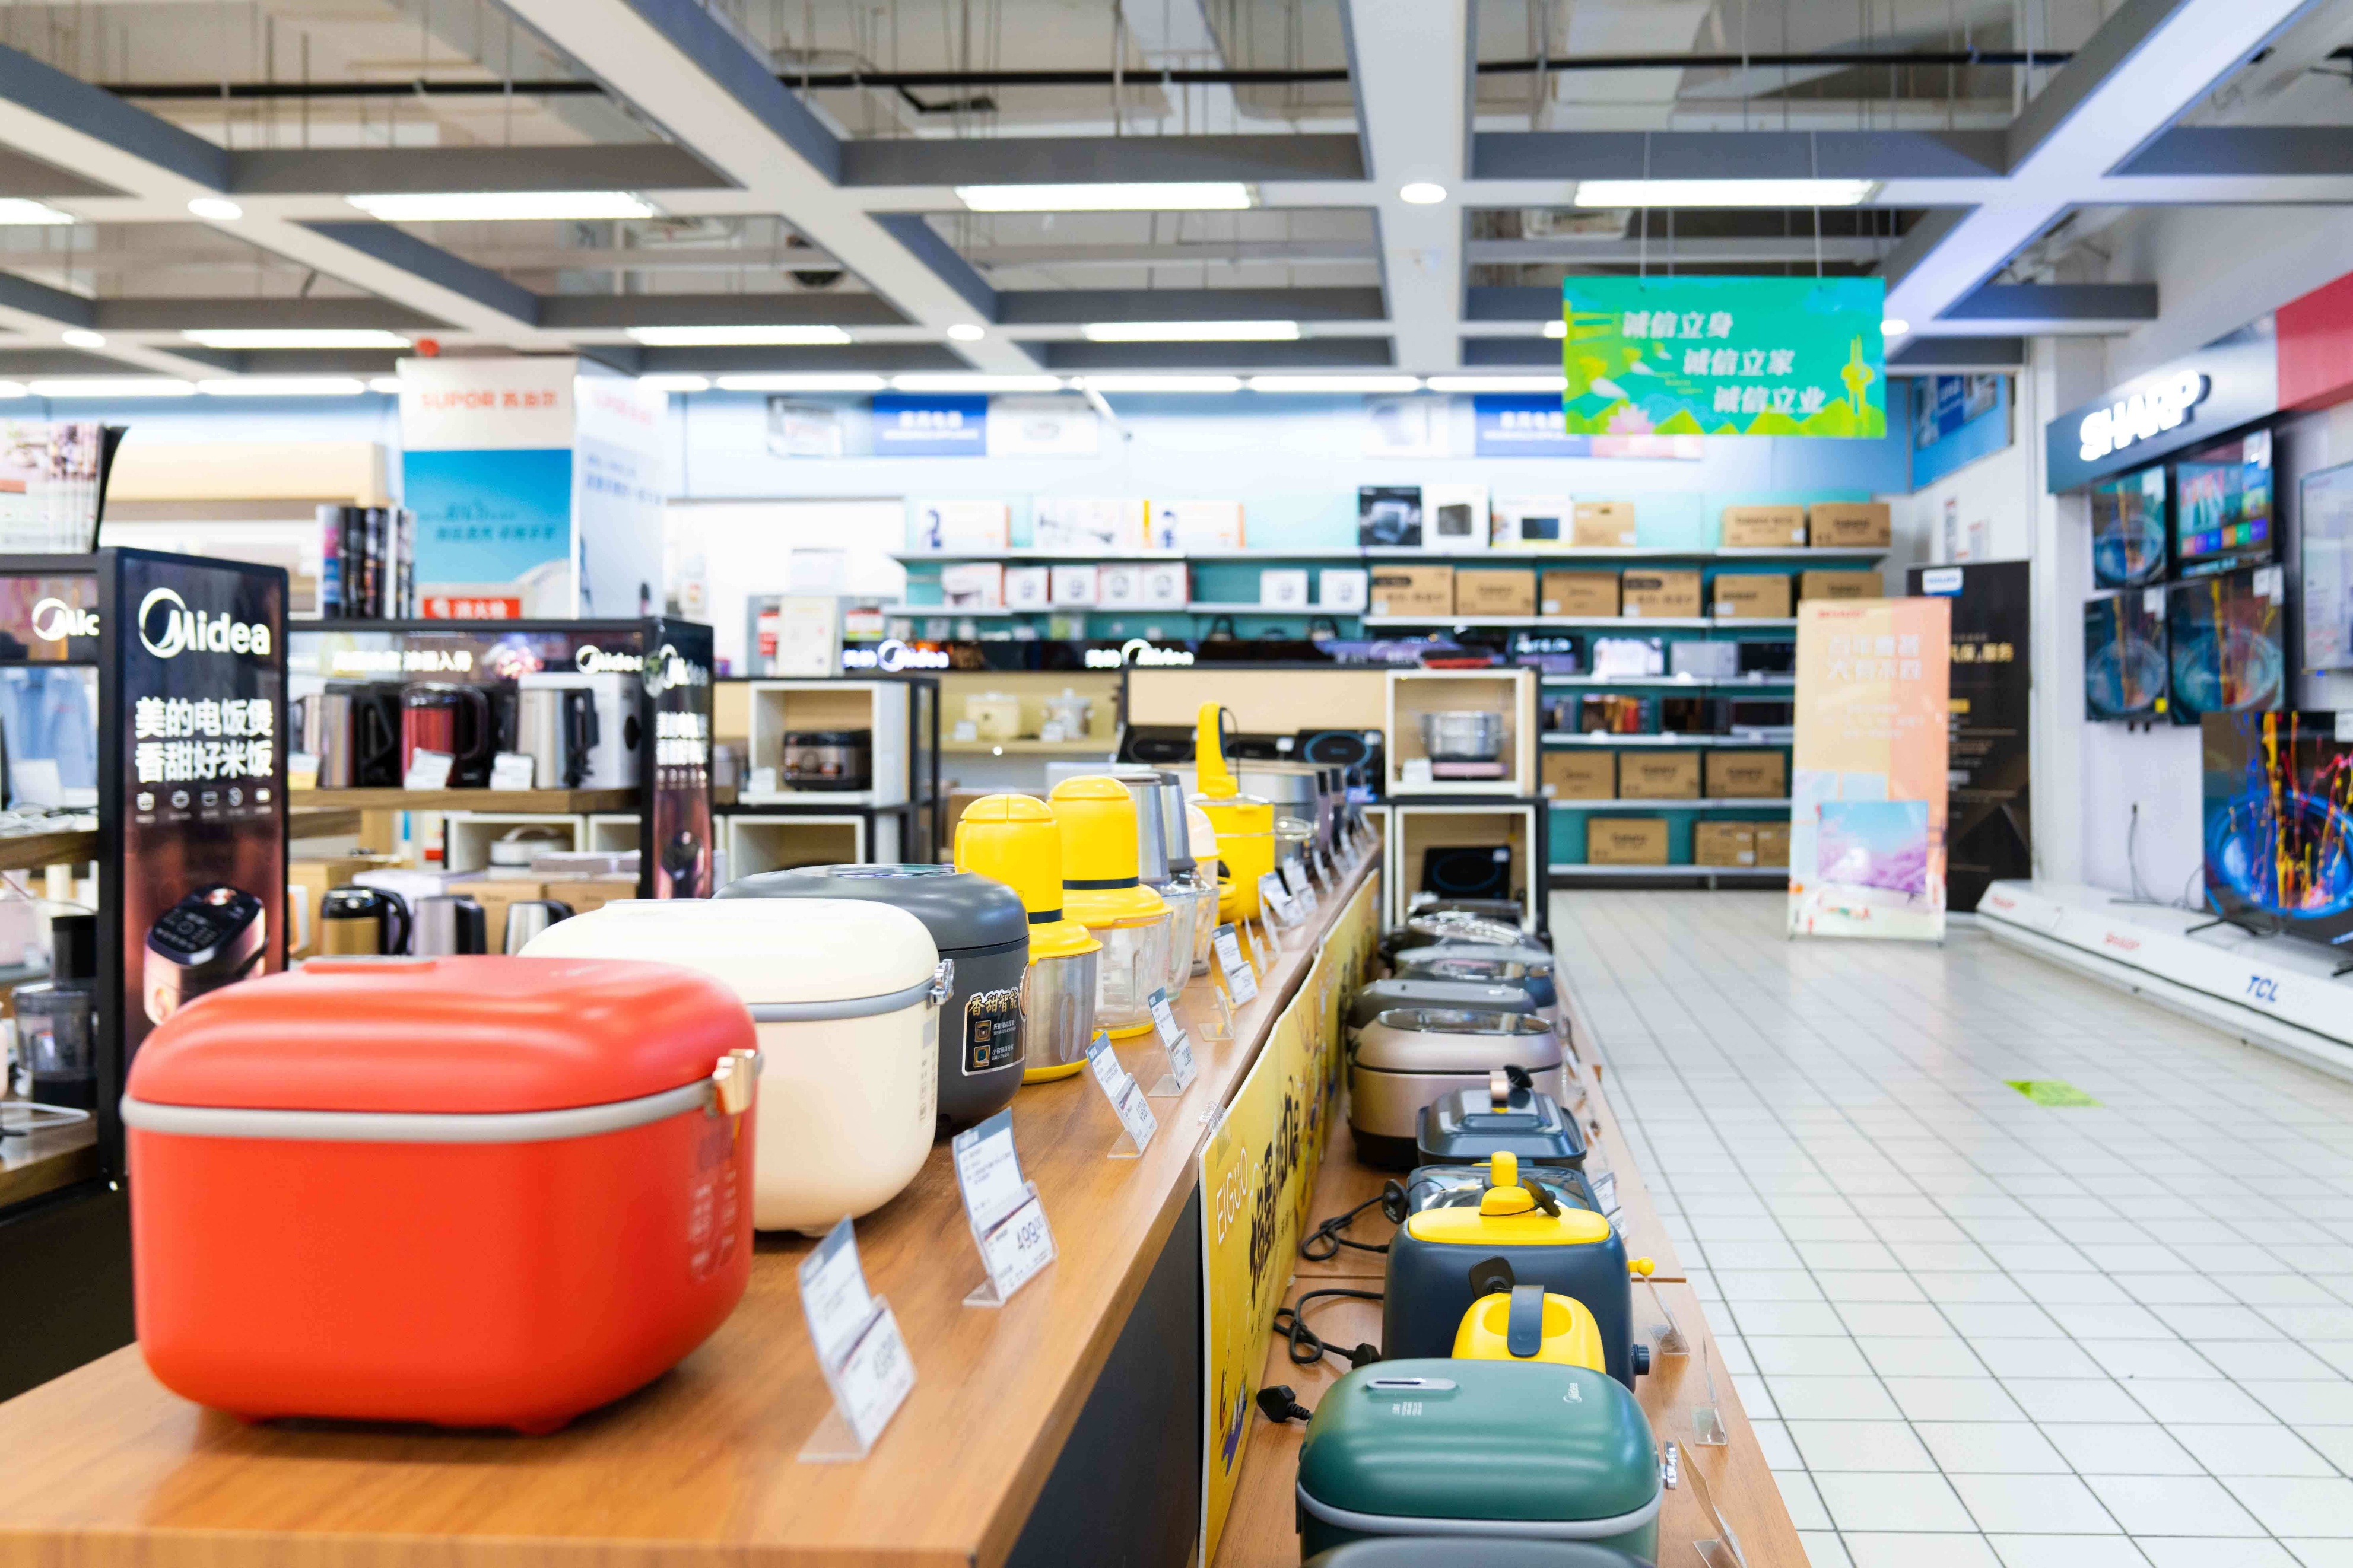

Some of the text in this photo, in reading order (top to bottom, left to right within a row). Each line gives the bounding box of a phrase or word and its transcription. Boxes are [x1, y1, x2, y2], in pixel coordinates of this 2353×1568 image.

[2080, 370, 2201, 462] SHARP
[139, 587, 271, 659] Midea
[135, 696, 274, 739] 美的电饭煲
[135, 739, 274, 783] 香甜好米饭
[968, 989, 1018, 1016] 香甜智能
[2246, 975, 2278, 1003] TCL
